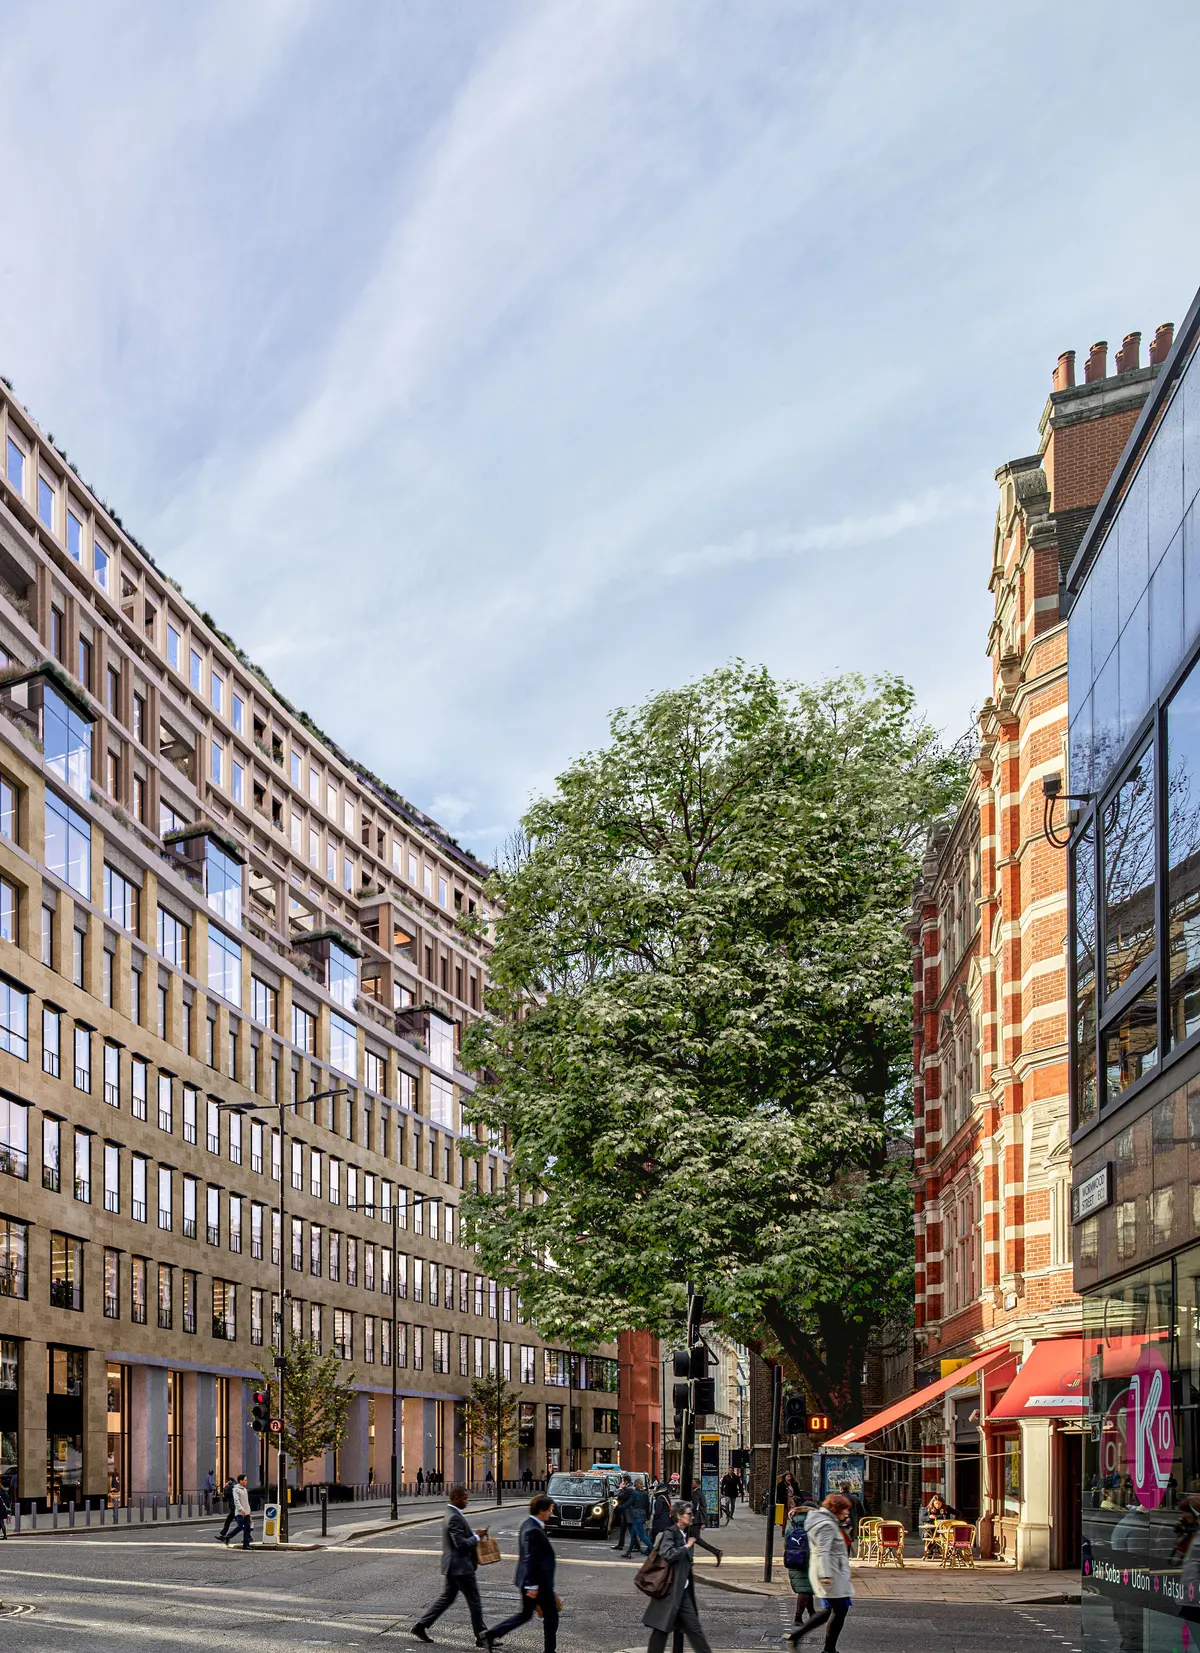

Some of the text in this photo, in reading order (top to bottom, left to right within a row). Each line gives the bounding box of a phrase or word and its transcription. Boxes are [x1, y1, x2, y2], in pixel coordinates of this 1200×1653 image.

[1081, 1174, 1105, 1198] WORMWOOD
[1081, 1194, 1094, 1211] STREET
[811, 1417, 827, 1430] 01
[1092, 1560, 1184, 1600] Yaki Soba Udon Katsu
